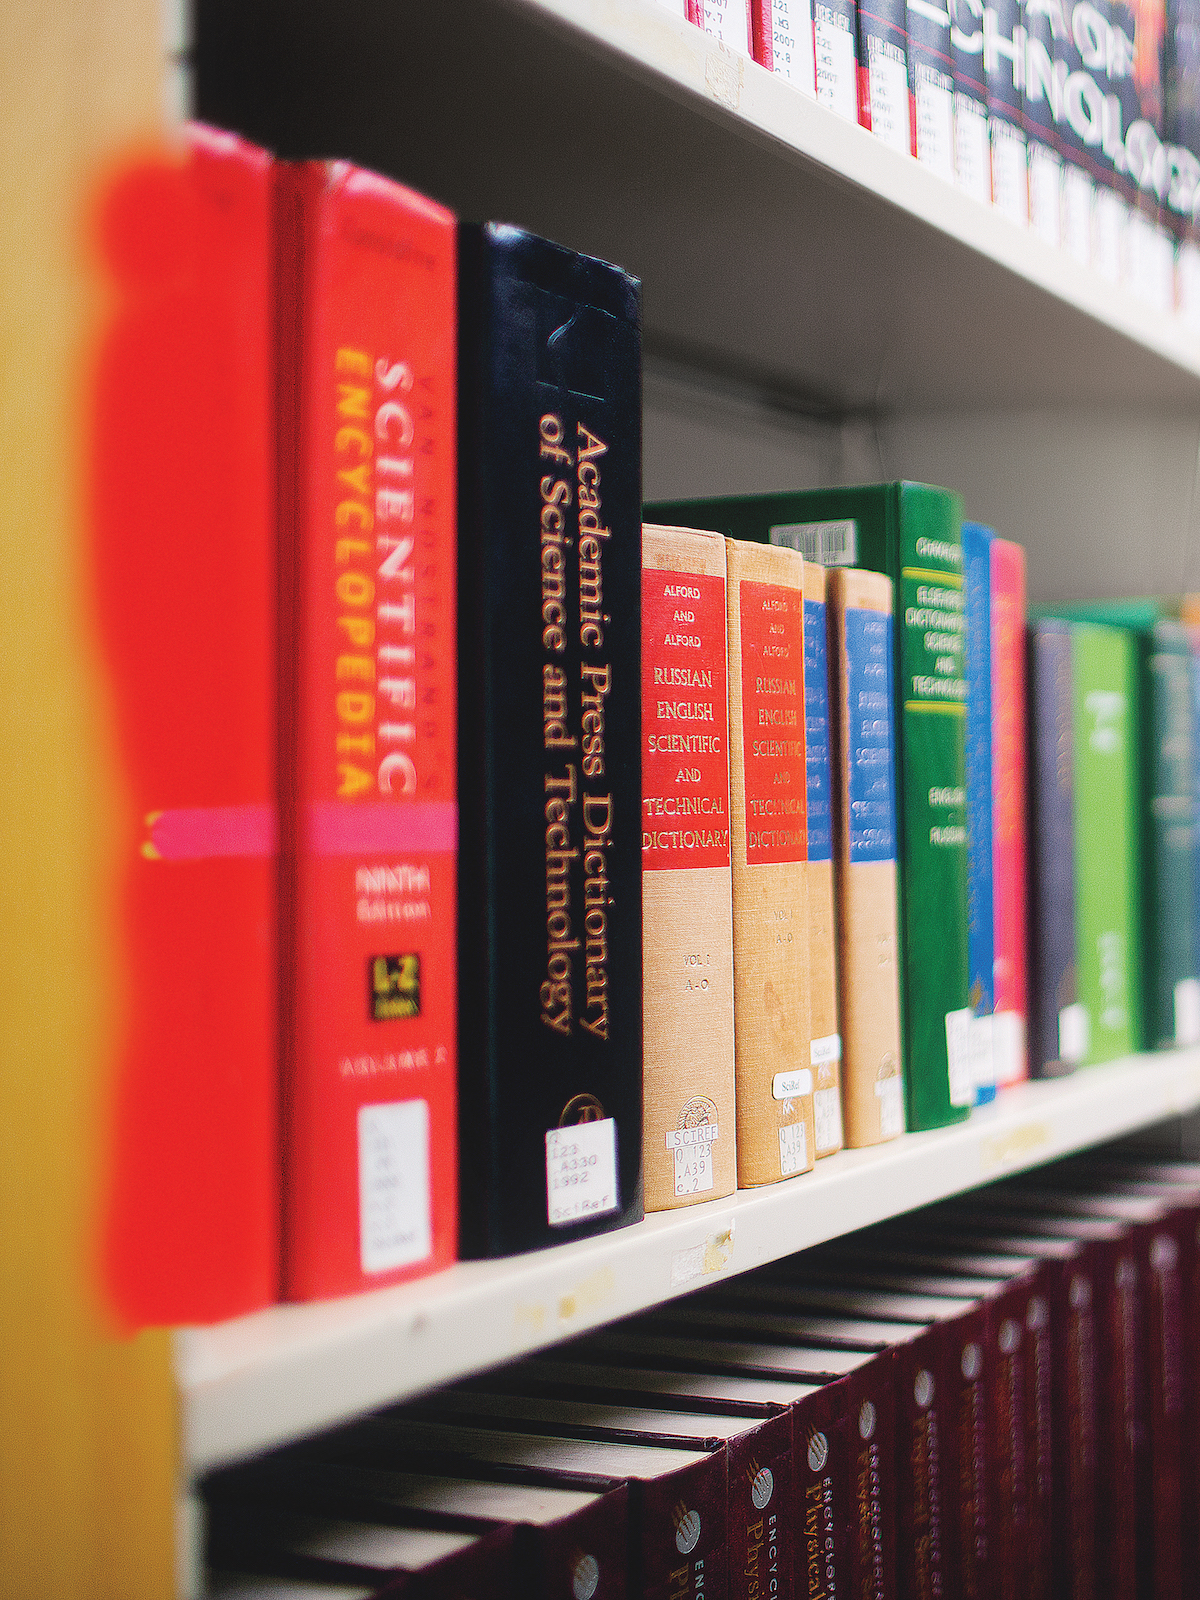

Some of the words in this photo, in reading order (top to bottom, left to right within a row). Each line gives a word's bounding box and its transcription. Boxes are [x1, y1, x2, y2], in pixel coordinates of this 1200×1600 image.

[773, 31, 795, 49] 2007
[773, 49, 791, 64] v.8
[539, 413, 574, 467] of
[577, 421, 613, 648] Academic
[335, 348, 376, 798] ENCYCLOPEDIA
[540, 475, 574, 651] Science
[374, 357, 417, 796] SCIENTIFIC
[664, 584, 701, 600] ALFORD
[673, 610, 695, 623] AND
[769, 623, 785, 634] AND
[664, 633, 701, 648] ALFORD
[762, 645, 789, 658] ALFORD
[653, 666, 712, 688] RUSSIAN
[756, 676, 796, 697] RUSSIAN
[542, 663, 579, 750] and
[656, 701, 714, 721] ENGLISH
[579, 660, 613, 778] Press
[758, 708, 797, 726] ENGLISH
[648, 734, 721, 754] SCIENTIFIC
[752, 739, 802, 757] SCIENTIFIC
[675, 768, 701, 782] AND
[773, 772, 791, 784] AND
[643, 797, 724, 816] TECHNICAL
[642, 829, 728, 850] DICTIONARY
[355, 864, 431, 893] NINTH
[540, 763, 581, 1036] Technology
[579, 791, 615, 1040] Dictionary
[682, 954, 703, 967] VOL
[781, 1078, 800, 1092] SciRef
[674, 1125, 717, 1146] SCIREF
[781, 1128, 786, 1143] Q
[790, 1123, 804, 1138] 123
[552, 1143, 578, 1160] 123
[676, 1148, 683, 1163] Q
[693, 1143, 711, 1158] 123
[782, 1140, 801, 1158] .A39
[678, 1160, 705, 1179] .A39
[553, 1170, 588, 1191] 1992
[676, 1178, 699, 1193] c.2
